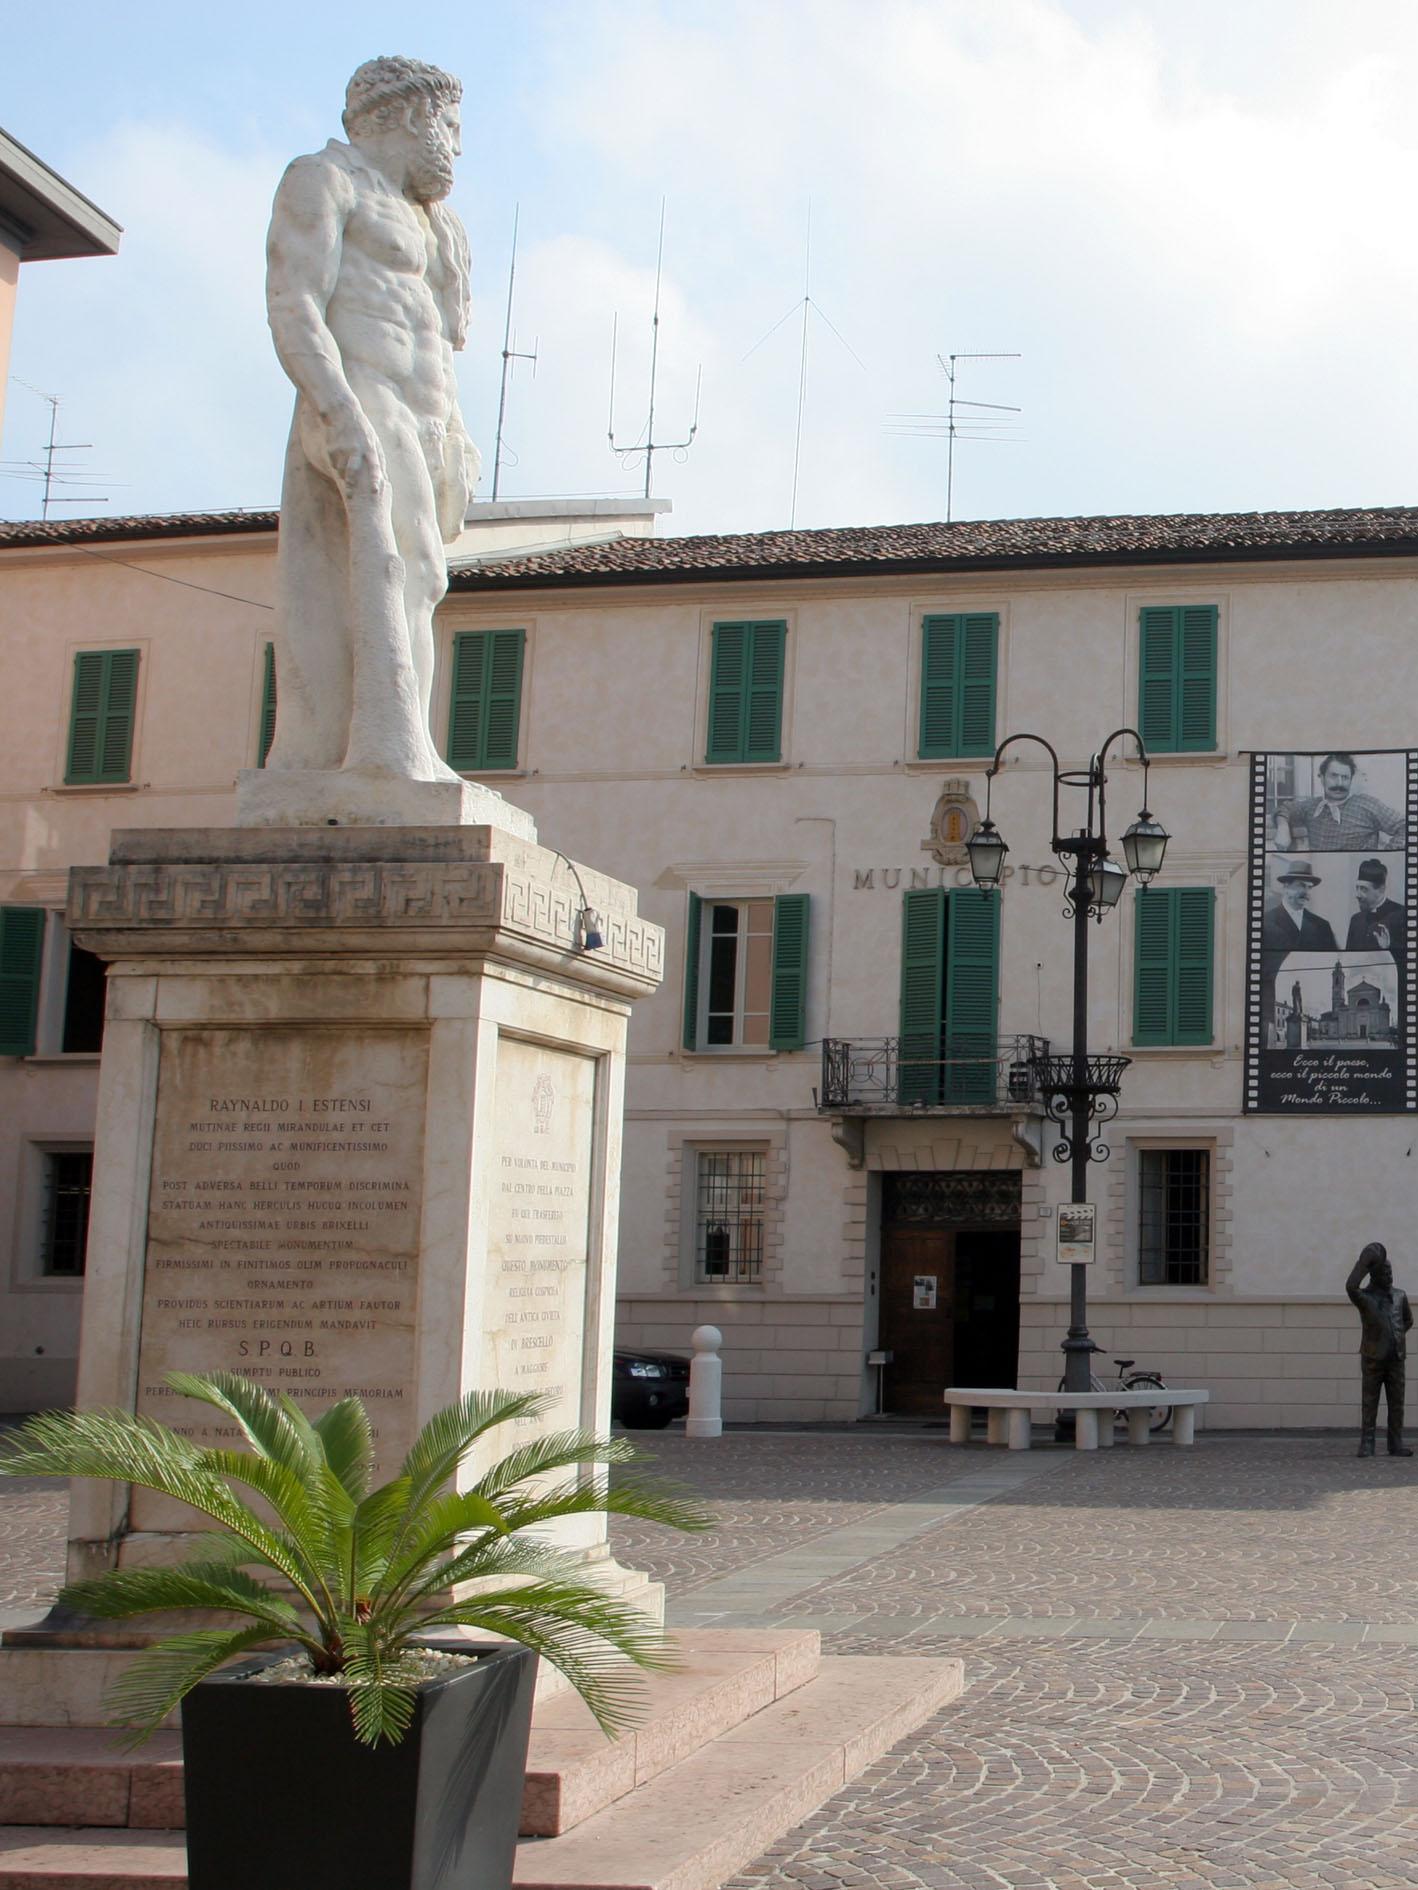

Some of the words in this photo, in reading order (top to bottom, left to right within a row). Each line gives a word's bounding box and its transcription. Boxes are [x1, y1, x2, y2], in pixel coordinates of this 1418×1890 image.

[853, 864, 1057, 890] MUNICPIO
[1293, 1054, 1319, 1066] Ecco
[1323, 1055, 1335, 1066] il
[1335, 1058, 1369, 1071] paese,
[1297, 1067, 1308, 1079] il
[1308, 1067, 1350, 1084] piccolo
[1353, 1067, 1393, 1079] mondo
[1314, 1080, 1328, 1091] di
[1280, 1092, 1323, 1104] Mondo
[210, 1099, 289, 1112] RAYNALDO
[312, 1099, 372, 1112] ESTENSI
[190, 1122, 238, 1133] MUTINAE
[244, 1122, 270, 1133] REGII
[277, 1122, 346, 1133] MIRANDULAE
[352, 1122, 364, 1133] ET
[370, 1122, 390, 1133] CET
[188, 1142, 213, 1152] DUCI
[270, 1142, 284, 1152] AC
[290, 1142, 388, 1152] MUNIFICENTISSIMO
[272, 1161, 301, 1172] QUOD
[162, 1180, 188, 1192] POST
[194, 1180, 242, 1192] ADVERSA
[249, 1180, 278, 1192] BELLI
[284, 1180, 342, 1192] TEMPORUM
[349, 1180, 410, 1192] DISCRIMINA
[162, 1200, 212, 1211] STATUAM
[218, 1200, 247, 1211] HANC
[252, 1200, 302, 1211] HERCULIS
[348, 1200, 408, 1211] INCOLUMEN
[198, 1220, 280, 1230] ANTIQUISSIMAE
[286, 1220, 316, 1230] URBIS
[322, 1220, 369, 1230] BRIXELLI
[210, 1240, 272, 1250] SPECTABILE
[278, 1240, 354, 1250] MONUMENTUM
[156, 1260, 213, 1270] FIRMISSIMI
[220, 1260, 231, 1270] IN
[237, 1260, 290, 1270] FINITIMOS
[296, 1260, 322, 1270] OLIM
[329, 1260, 408, 1270] PROPUGNACULI
[247, 1280, 314, 1290] ORNAMENTO
[157, 1300, 208, 1310] PROVIDUS
[214, 1300, 284, 1310] SCIENTIARUM
[291, 1300, 305, 1310] AC
[312, 1300, 354, 1310] ARTIUM
[360, 1300, 400, 1310] FAUTOR
[178, 1320, 202, 1330] HEIC
[208, 1320, 247, 1330] RURSUS
[252, 1320, 313, 1330] ERIGENDUM
[320, 1320, 377, 1330] MANDAVIT
[521, 1335, 554, 1349] BRESCELLO
[230, 1368, 272, 1378] SUMPTU
[278, 1368, 321, 1378] PUBLICO
[287, 1387, 337, 1398] PRINCIPIS
[343, 1387, 403, 1398] MEMORIAM
